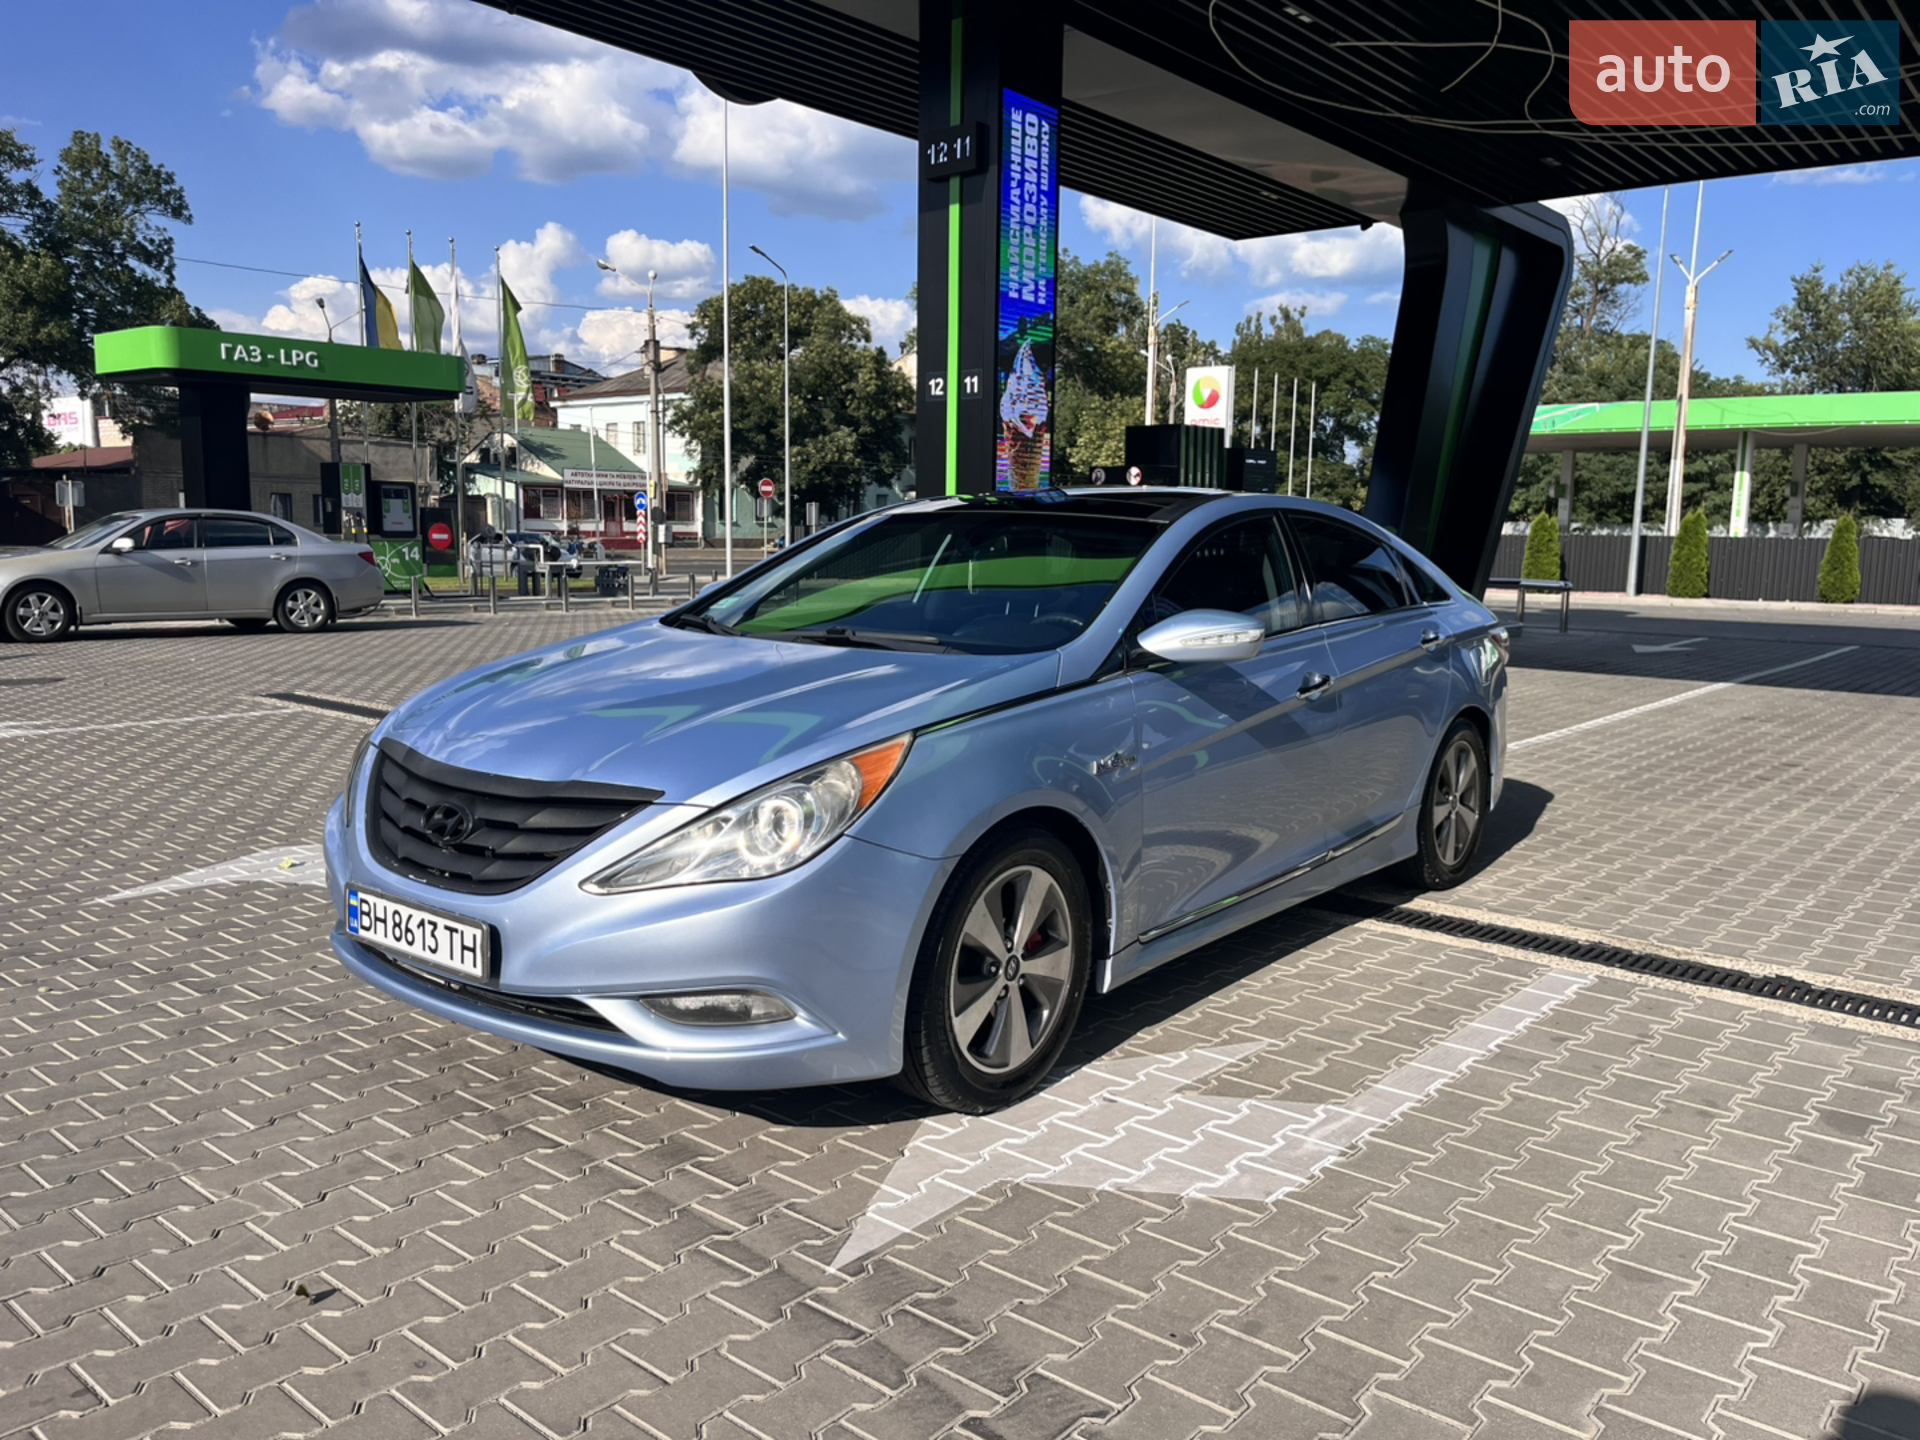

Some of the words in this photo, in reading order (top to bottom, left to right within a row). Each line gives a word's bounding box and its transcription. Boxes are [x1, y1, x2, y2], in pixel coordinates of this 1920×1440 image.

[927, 141, 948, 165] 12
[953, 135, 970, 159] 11
[1040, 120, 1050, 192] ШЛЯХУ
[1008, 107, 1023, 299] НАЙСМАЧНІШЕ
[1022, 112, 1039, 302] МОРОЗИВО
[1038, 279, 1047, 305] НА
[220, 342, 262, 363] ГАЗ
[280, 348, 319, 368] LPG
[928, 377, 945, 396] 12
[963, 375, 978, 394] 11
[402, 546, 420, 561] 14
[359, 898, 388, 939] BH
[391, 909, 439, 955] 8613
[443, 924, 477, 969] TH
